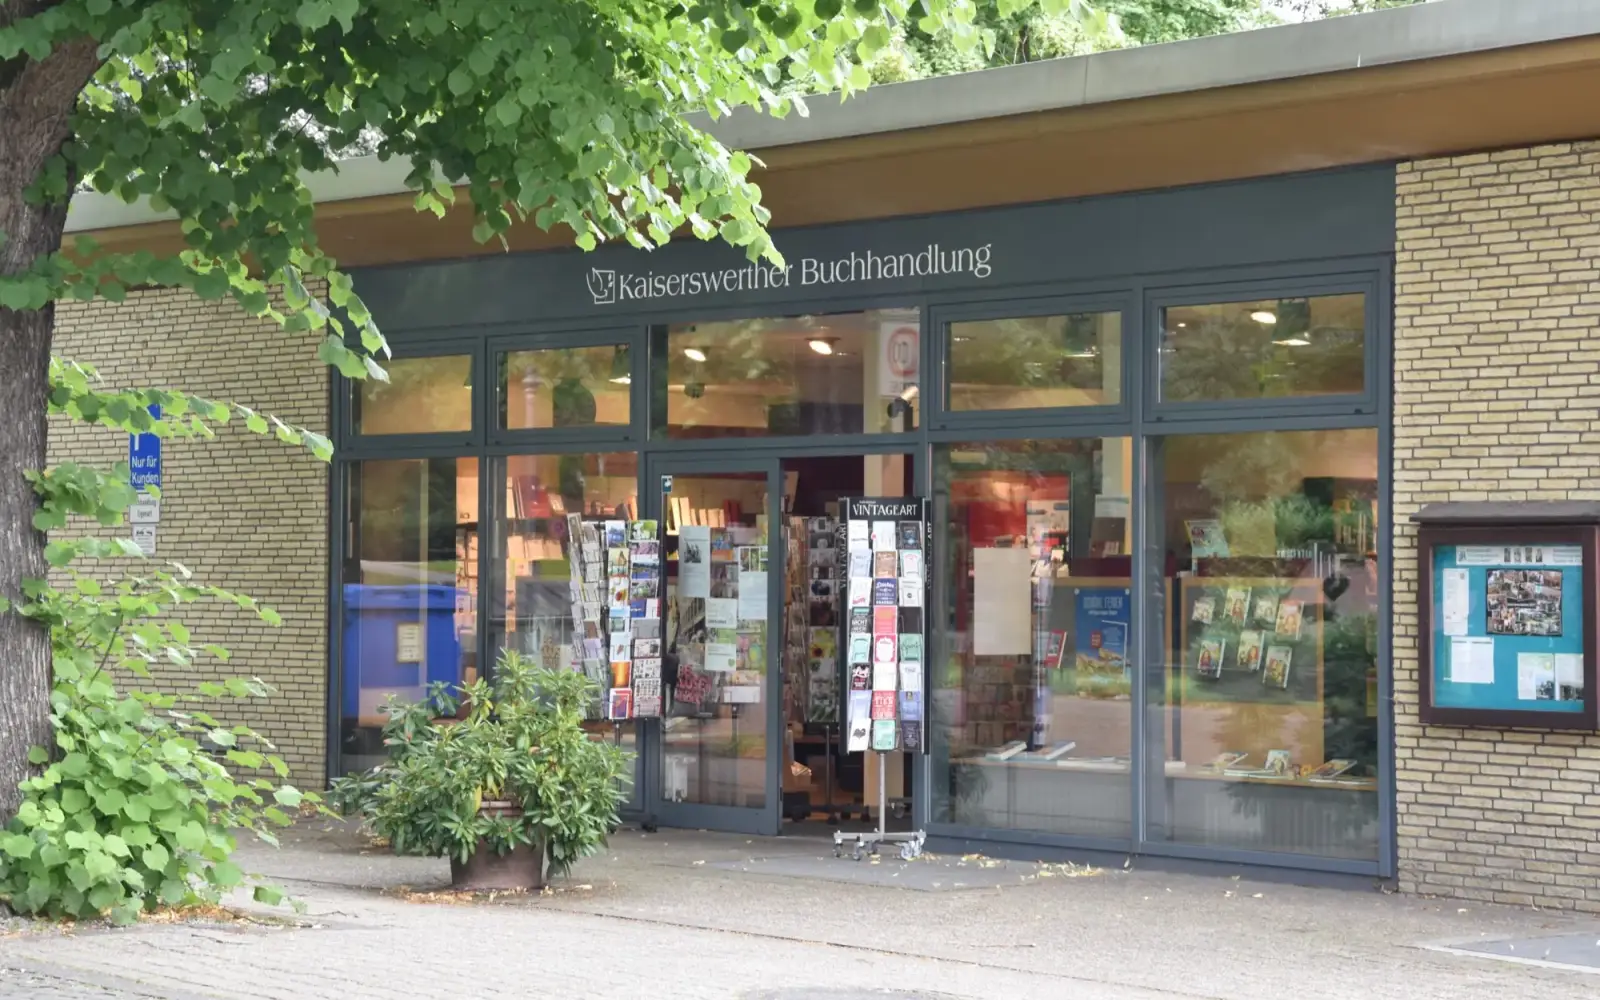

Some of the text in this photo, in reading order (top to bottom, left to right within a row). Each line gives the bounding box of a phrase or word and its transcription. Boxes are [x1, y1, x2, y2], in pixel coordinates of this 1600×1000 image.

[619, 243, 992, 300] Kaiserswerther Buchhandlung
[131, 454, 157, 468] Nur für
[131, 471, 158, 484] Kunden
